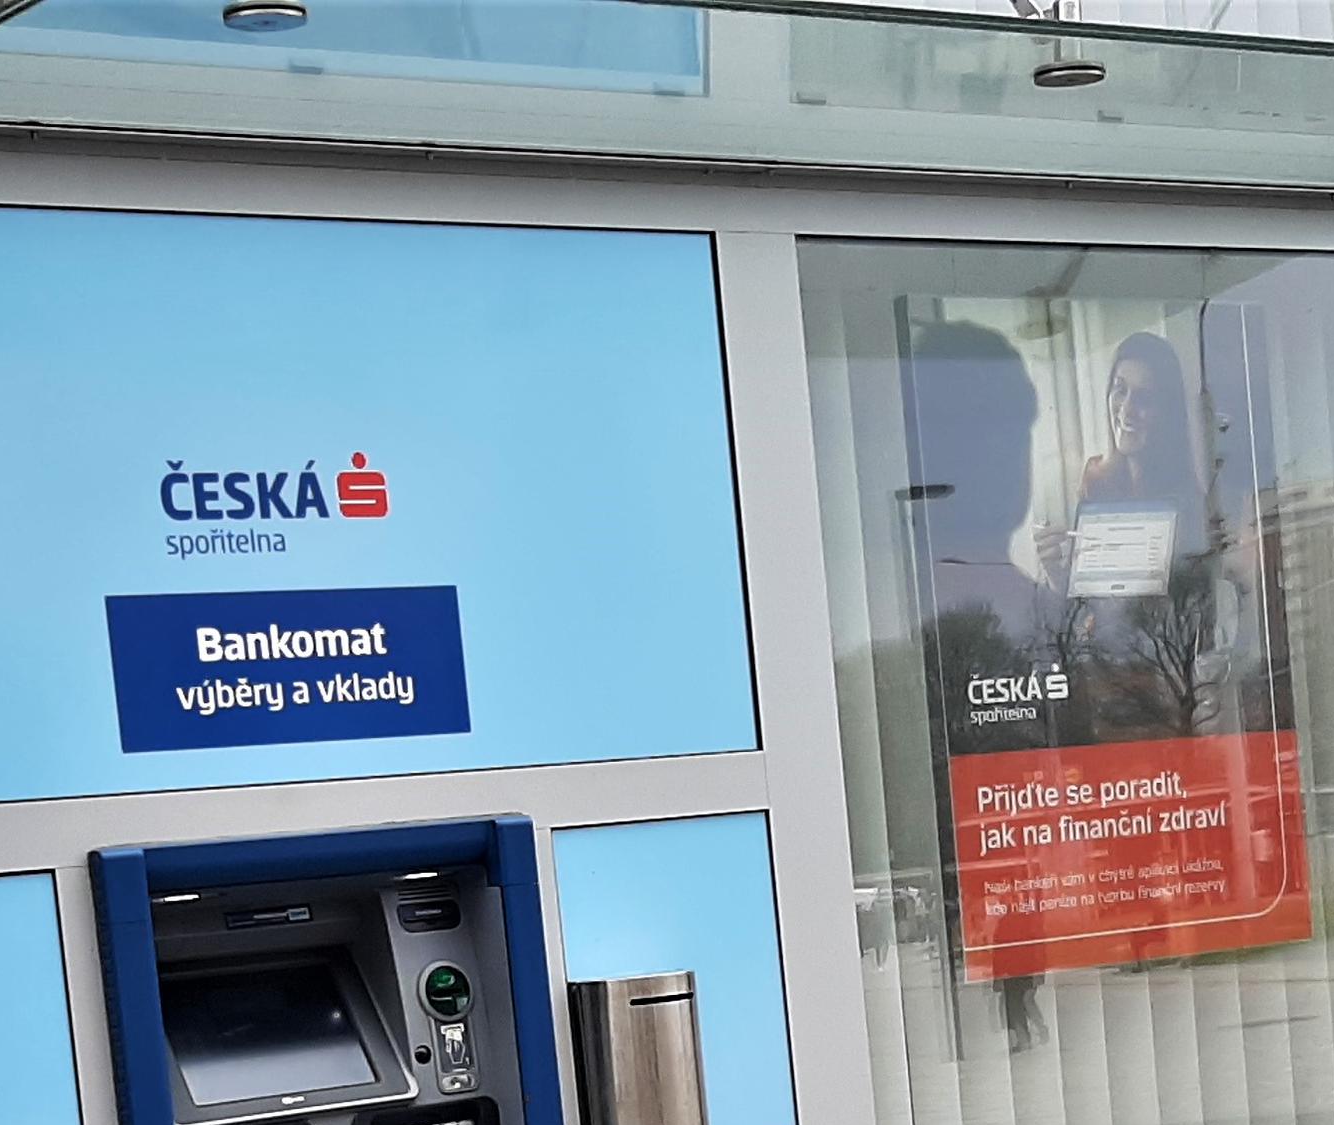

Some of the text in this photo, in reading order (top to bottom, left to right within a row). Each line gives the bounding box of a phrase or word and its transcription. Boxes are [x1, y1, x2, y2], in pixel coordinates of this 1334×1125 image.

[160, 460, 329, 521] ČESKÁ
[166, 529, 286, 560] spořitelna
[196, 622, 387, 662] Bankomat
[176, 671, 414, 715] výběry a vklady
[968, 670, 1043, 704] ČESKÁ
[977, 771, 1187, 816] Přijďte se poradit,
[980, 800, 1226, 856] jak na finanční zdraví
